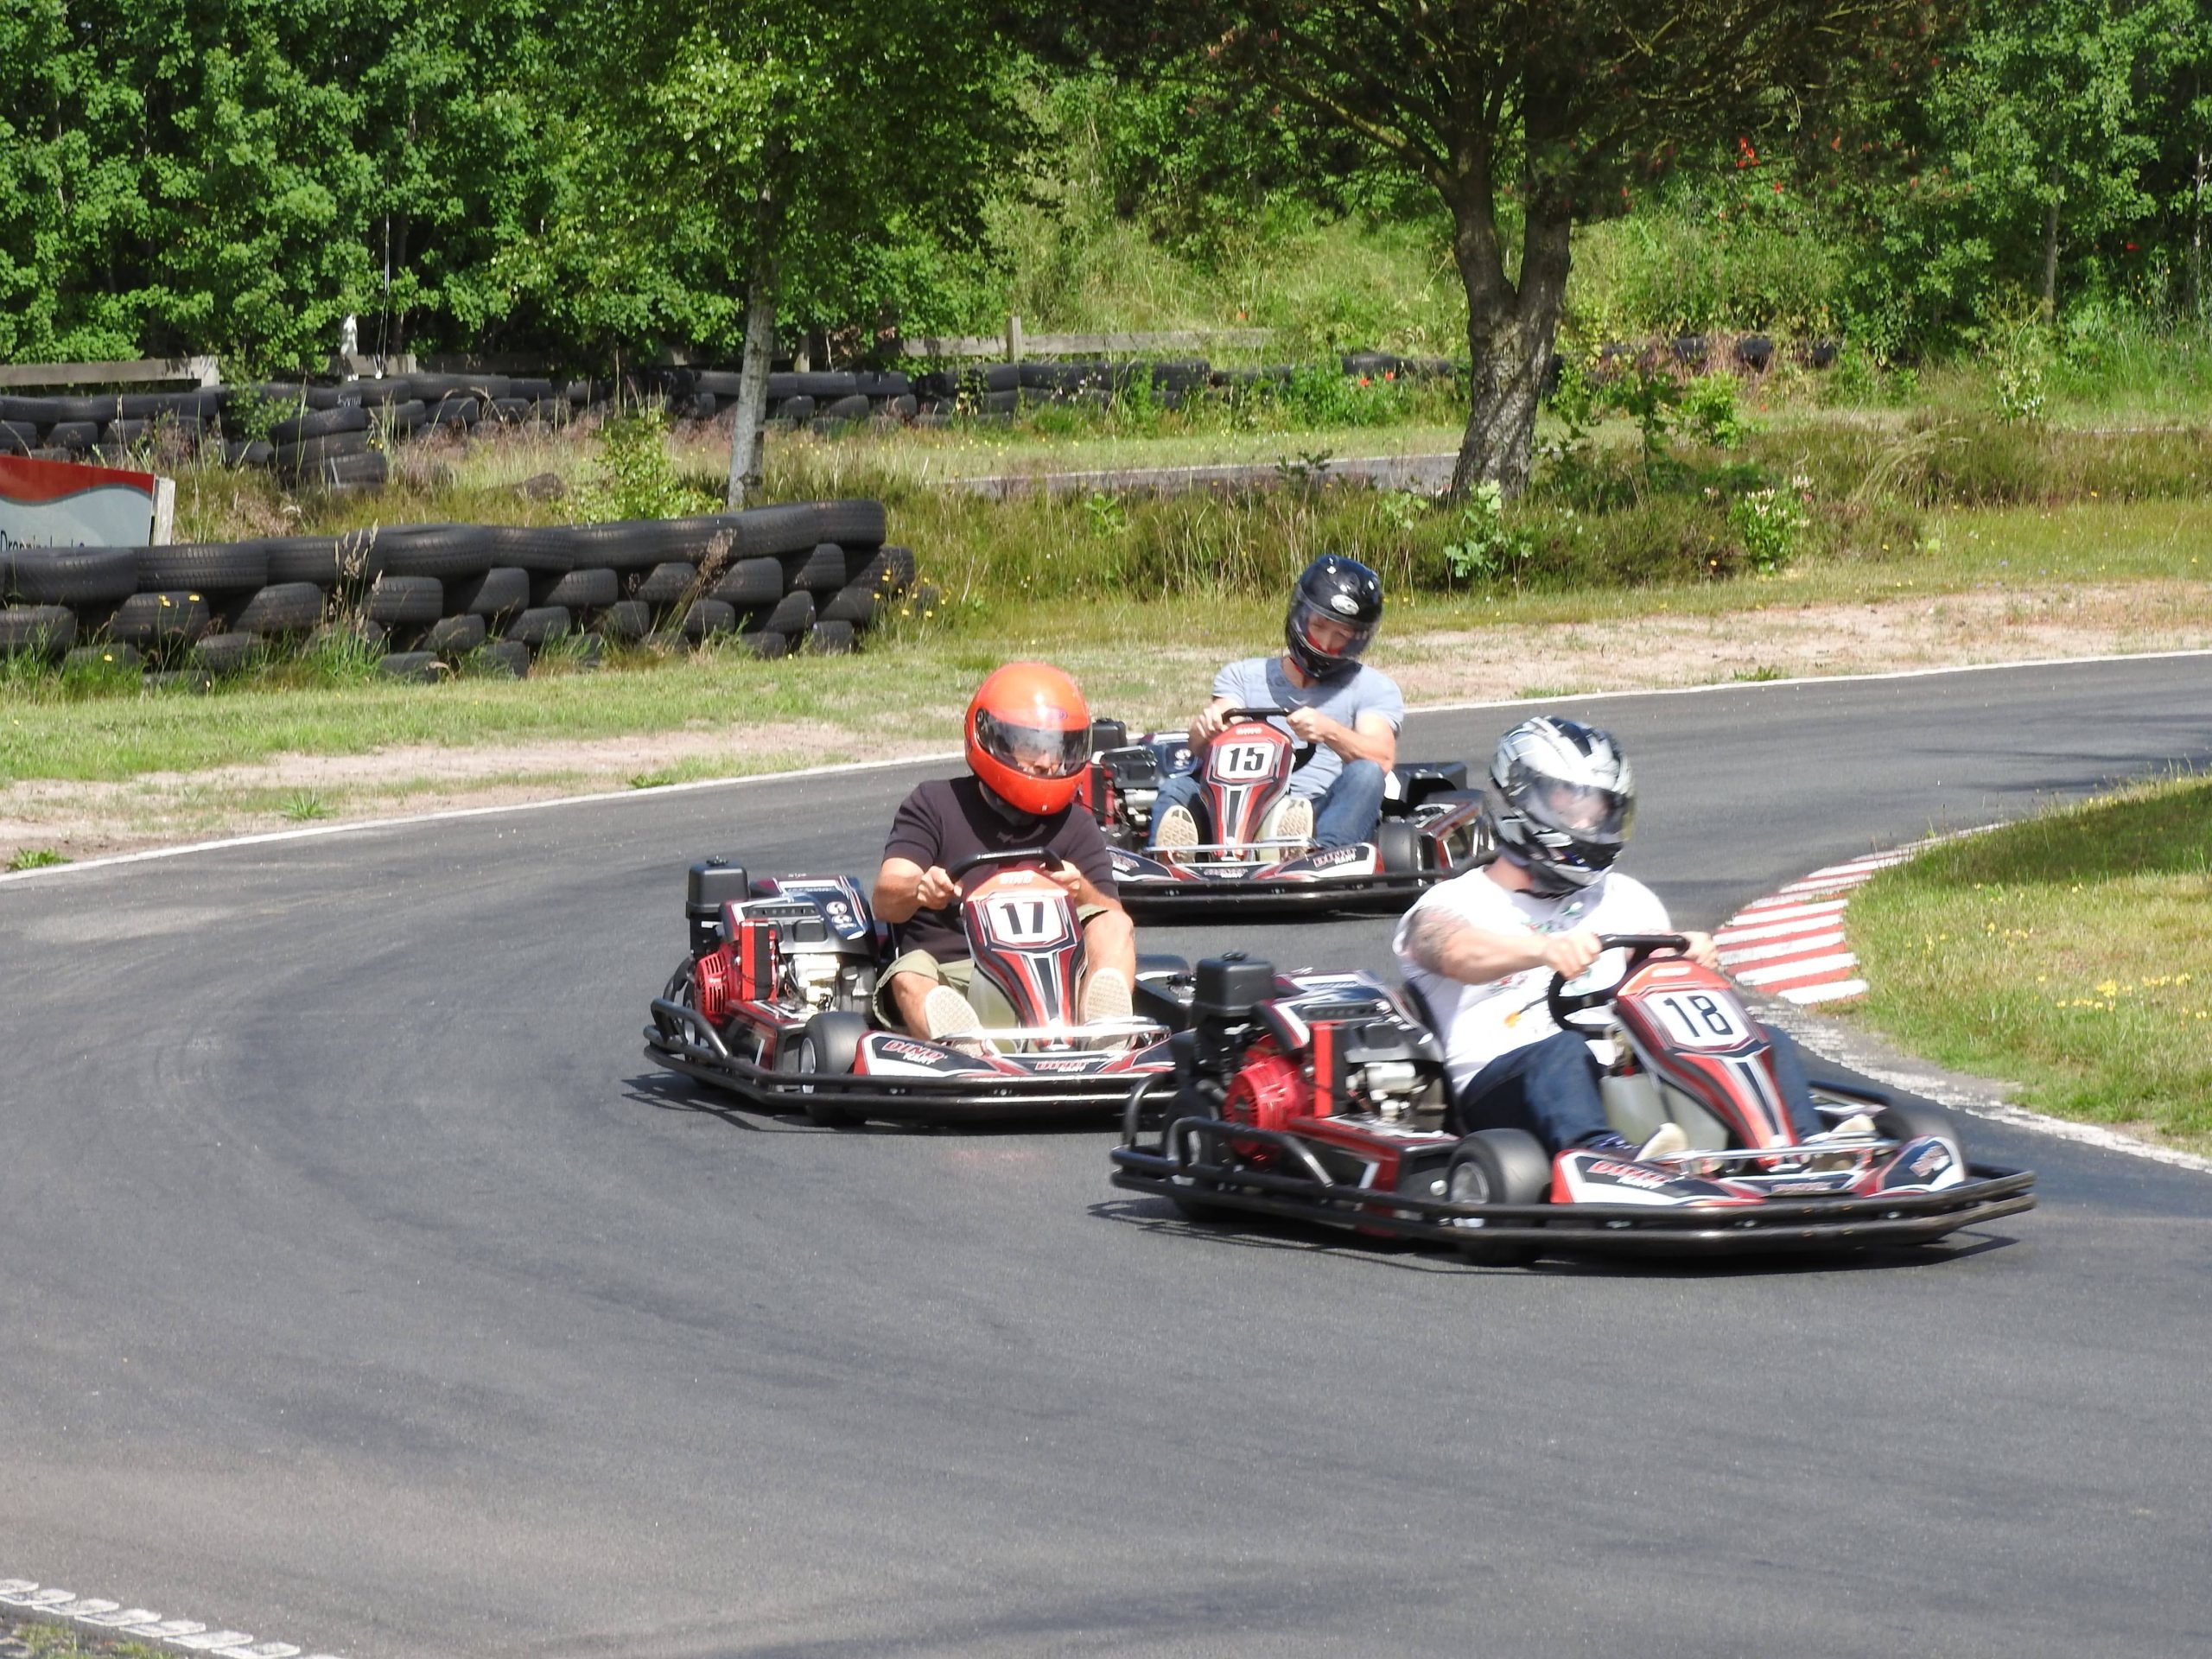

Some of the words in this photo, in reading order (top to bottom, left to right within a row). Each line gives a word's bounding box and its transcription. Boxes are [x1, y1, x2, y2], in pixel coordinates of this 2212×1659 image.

[1229, 747, 1266, 772] 15
[1000, 901, 1044, 935] 17
[1662, 995, 1734, 1037] 18
[881, 1039, 945, 1059] DINO
